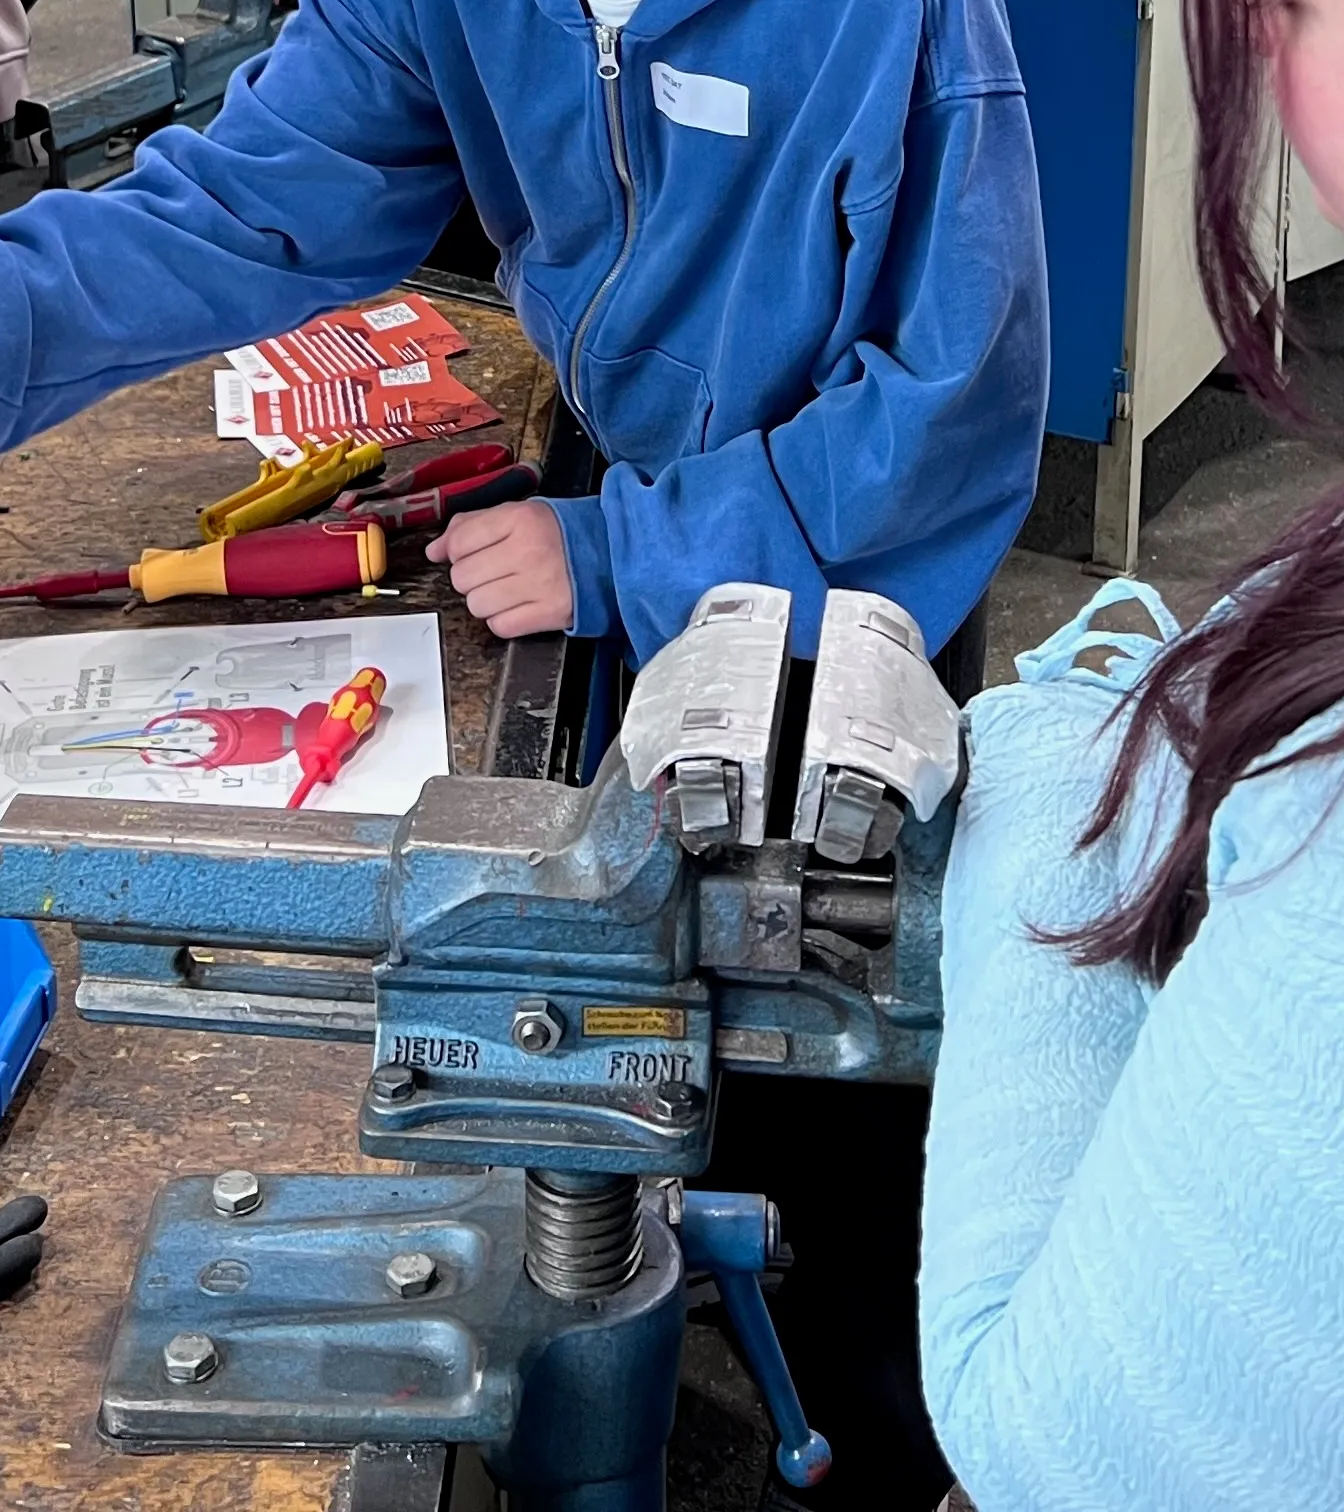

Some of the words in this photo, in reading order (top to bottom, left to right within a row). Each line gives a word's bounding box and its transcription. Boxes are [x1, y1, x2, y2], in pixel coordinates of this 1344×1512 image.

[221, 777, 244, 788] L2
[392, 1034, 479, 1070] HEUER
[608, 1050, 692, 1083] FRONT
